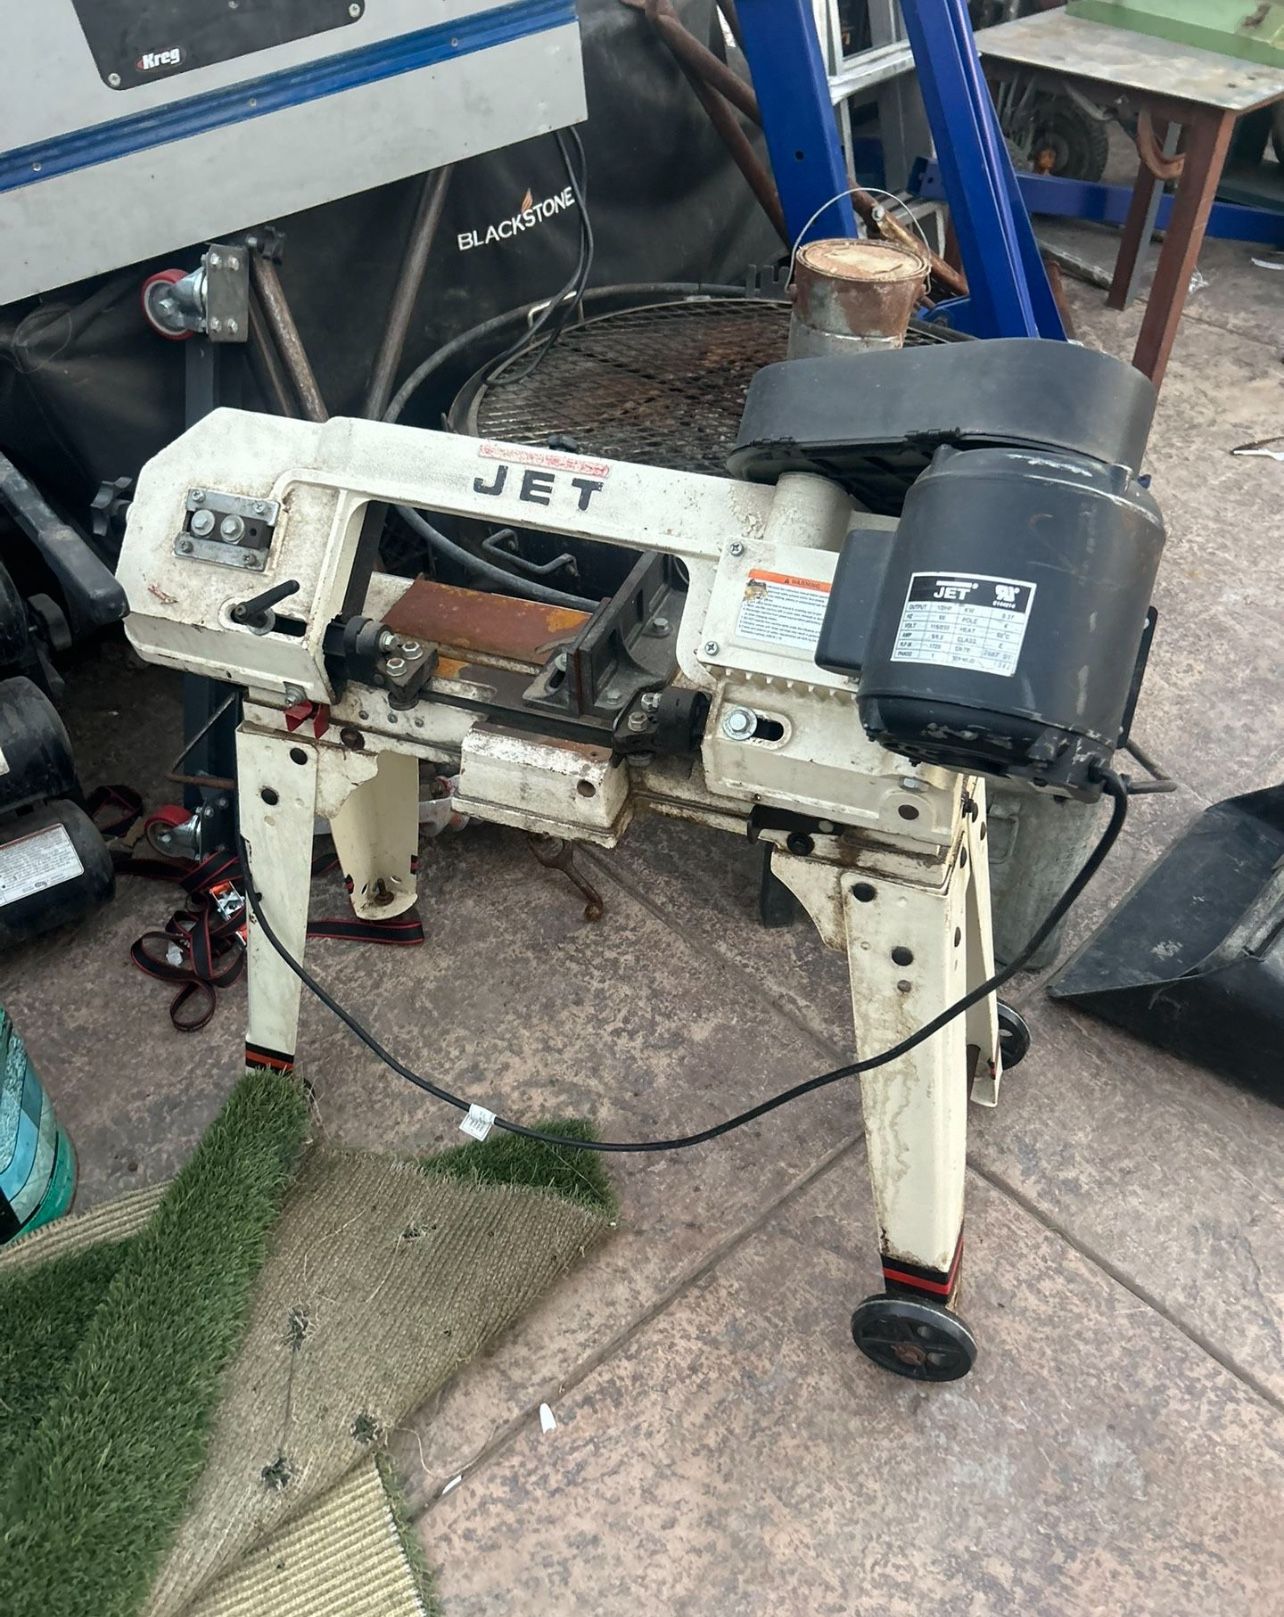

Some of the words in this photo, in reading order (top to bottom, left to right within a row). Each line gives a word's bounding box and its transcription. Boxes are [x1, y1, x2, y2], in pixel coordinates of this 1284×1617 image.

[142, 48, 180, 70] Kreg
[457, 186, 575, 251] BLACKSTONE
[473, 465, 604, 511] JET
[933, 587, 971, 600] JET
